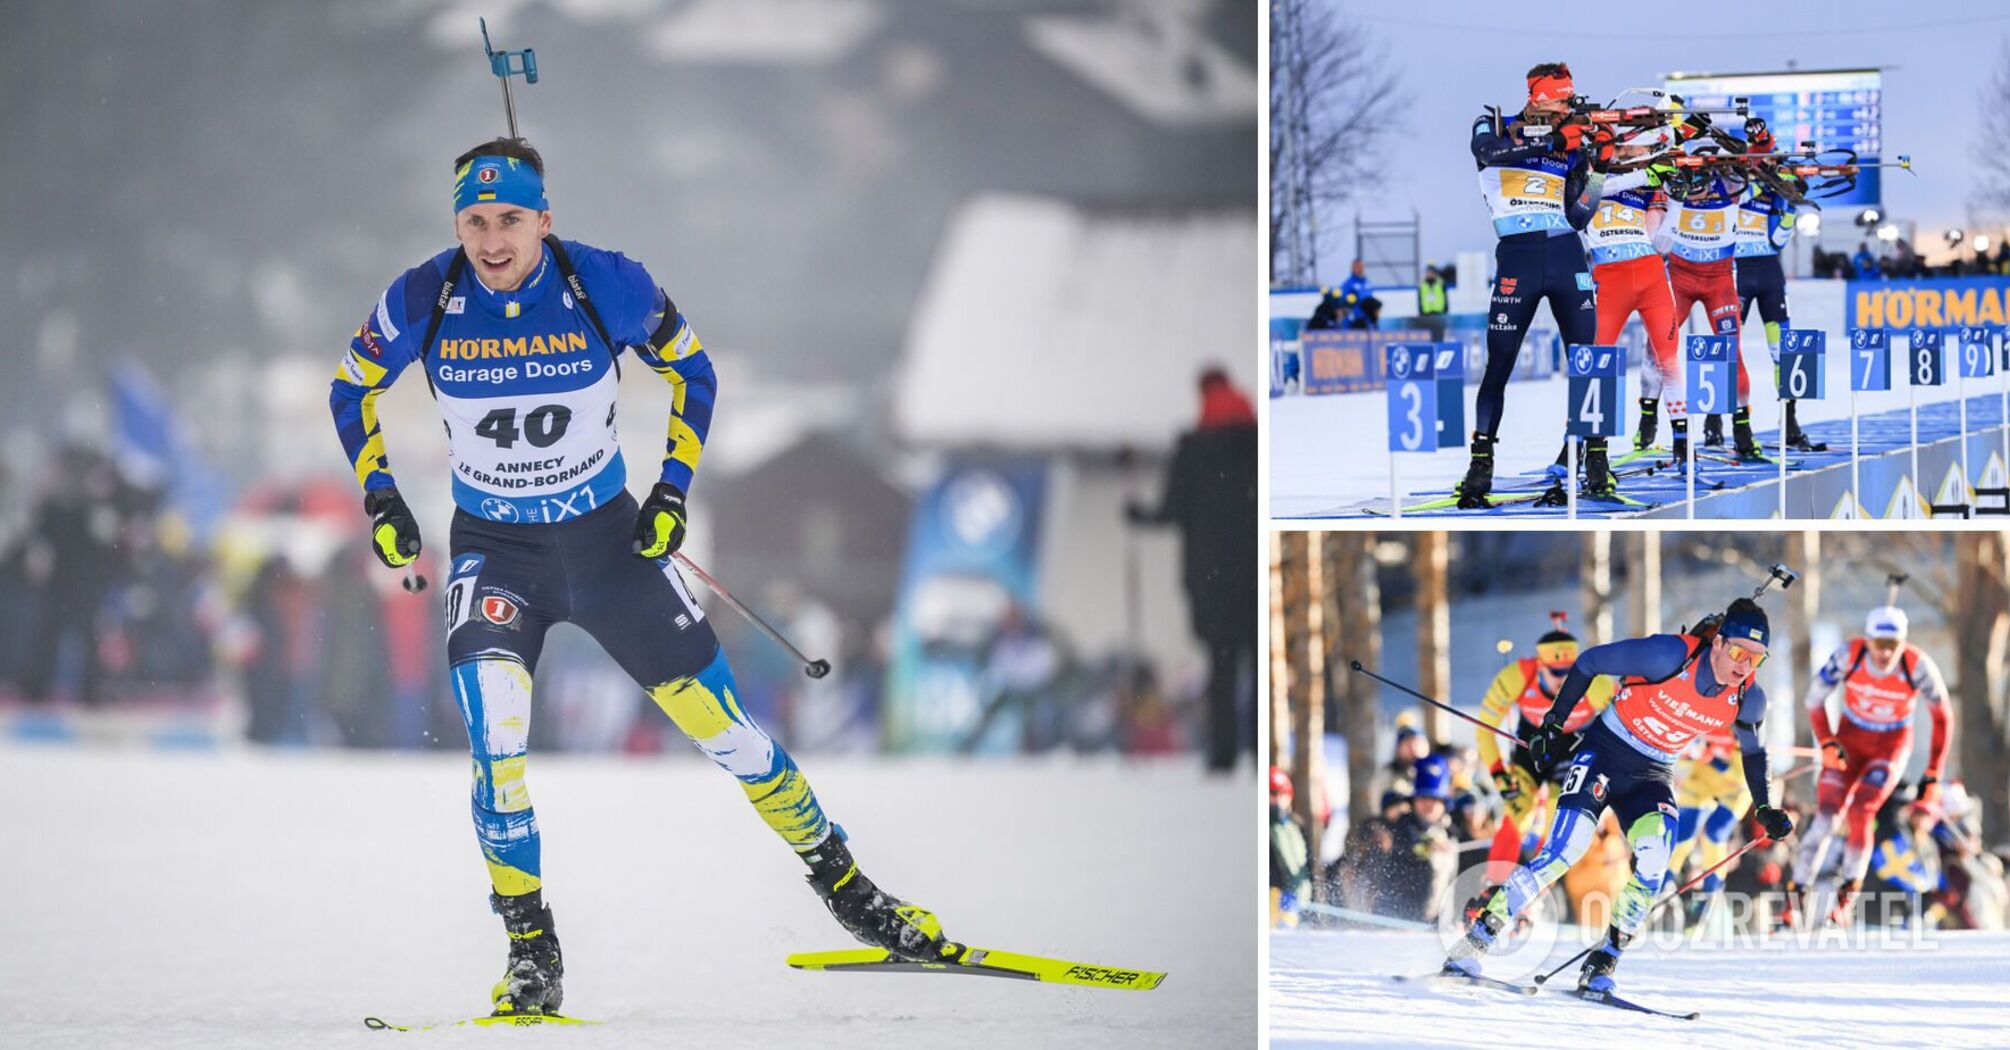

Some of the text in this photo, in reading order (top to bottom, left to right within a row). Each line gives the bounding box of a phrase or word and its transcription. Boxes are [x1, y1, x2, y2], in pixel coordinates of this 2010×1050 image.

[1524, 176, 1547, 195] 2
[1600, 205, 1634, 223] 14
[1690, 214, 1706, 230] 6
[439, 331, 588, 361] HÖRMANN
[1965, 344, 1979, 377] 9
[438, 359, 593, 385] Garage Doors
[1789, 354, 1807, 398] 6
[1859, 351, 1875, 390] 7
[1917, 349, 1933, 385] 8
[1697, 363, 1716, 413] 5
[1400, 382, 1424, 451] 3
[1579, 377, 1604, 435] 4
[475, 404, 573, 450] 40
[458, 448, 605, 489] LE GRAND-BORNAND
[495, 455, 566, 473] ANNECY
[1063, 965, 1140, 986] FISCHER
